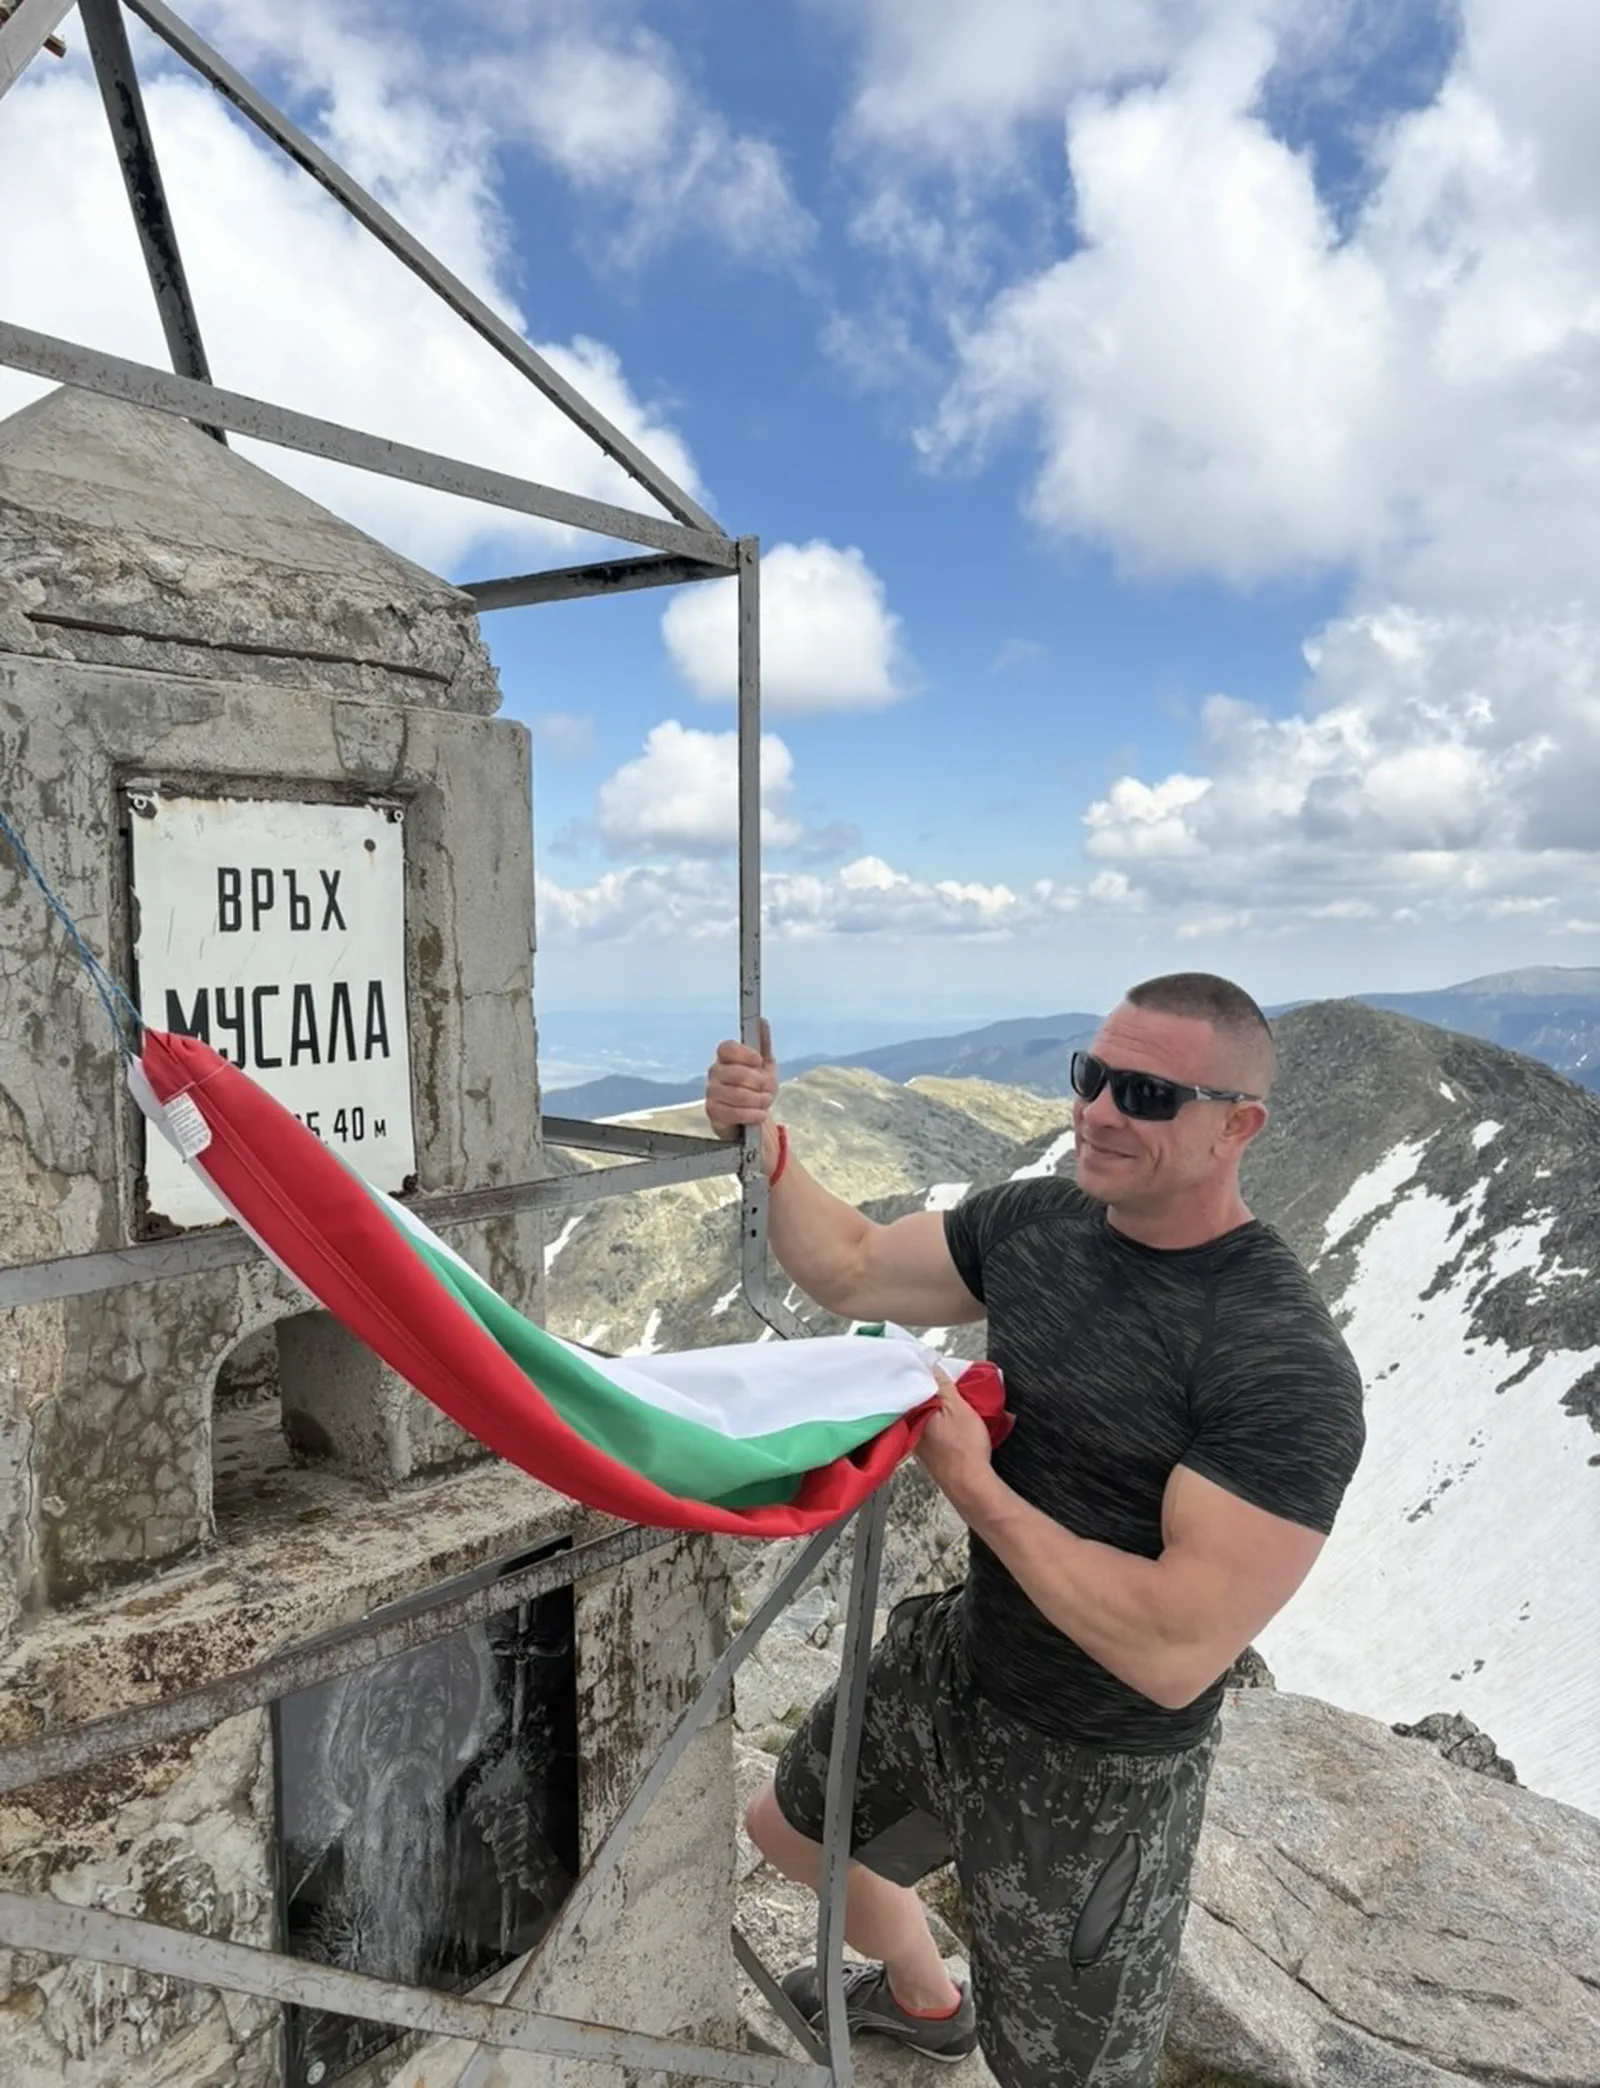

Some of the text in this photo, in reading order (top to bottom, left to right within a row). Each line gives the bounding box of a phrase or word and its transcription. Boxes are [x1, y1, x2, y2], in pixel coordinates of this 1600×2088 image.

[217, 867, 347, 932] ВРЪХ
[165, 980, 391, 1070] МУСАЛА
[294, 1106, 365, 1144] 5.40
